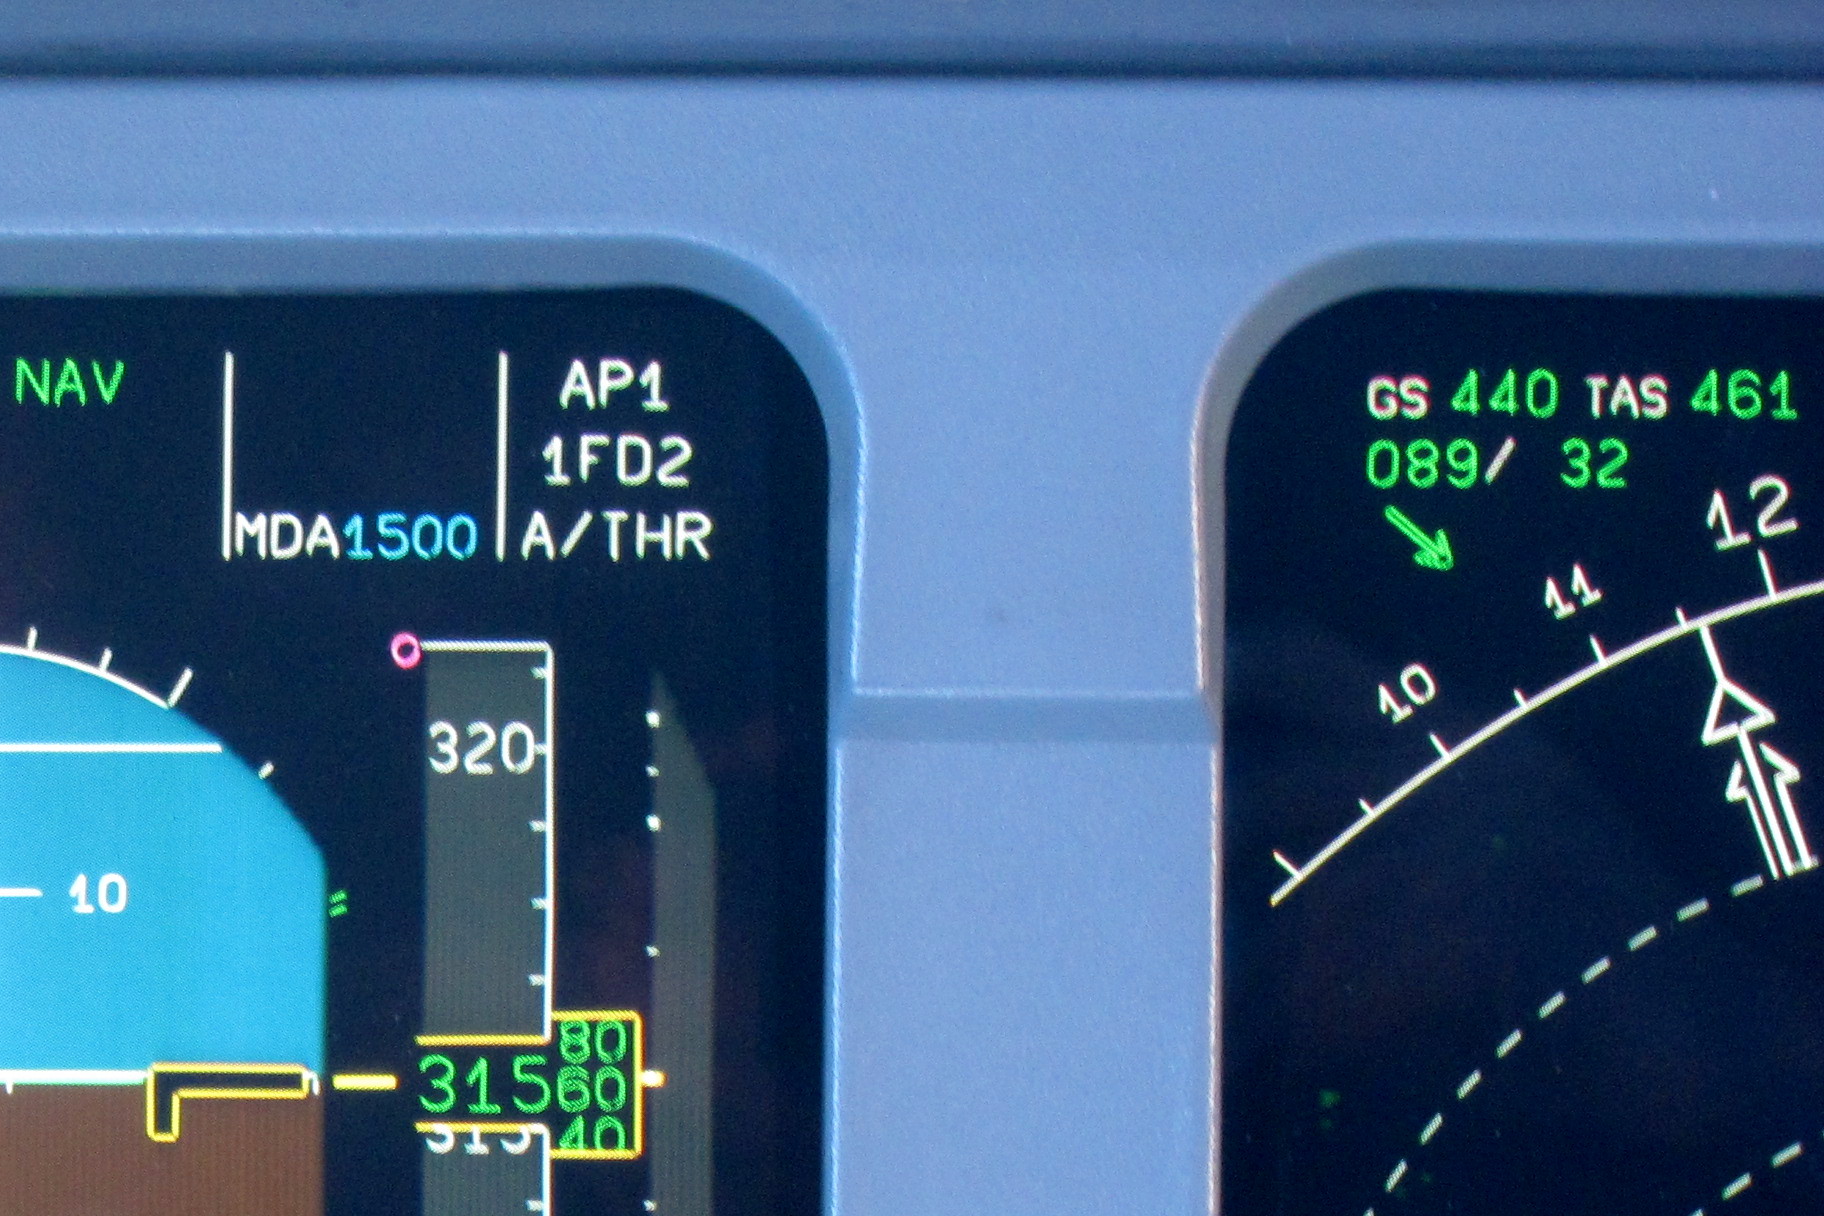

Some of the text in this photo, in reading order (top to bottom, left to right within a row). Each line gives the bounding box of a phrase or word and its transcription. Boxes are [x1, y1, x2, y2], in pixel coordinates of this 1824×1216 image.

[15, 358, 125, 406] NAV
[560, 359, 669, 412] AP1
[1366, 368, 1798, 420] GS 440 TAS 461
[542, 434, 692, 487] 1FD2
[1561, 437, 1629, 488] 32
[521, 510, 714, 562] A/THR
[1705, 474, 1799, 553] 12
[1544, 563, 1603, 620] 11
[1378, 663, 1437, 723] 10
[427, 721, 536, 775] 320
[69, 872, 128, 914] 10
[558, 1020, 628, 1065] 80
